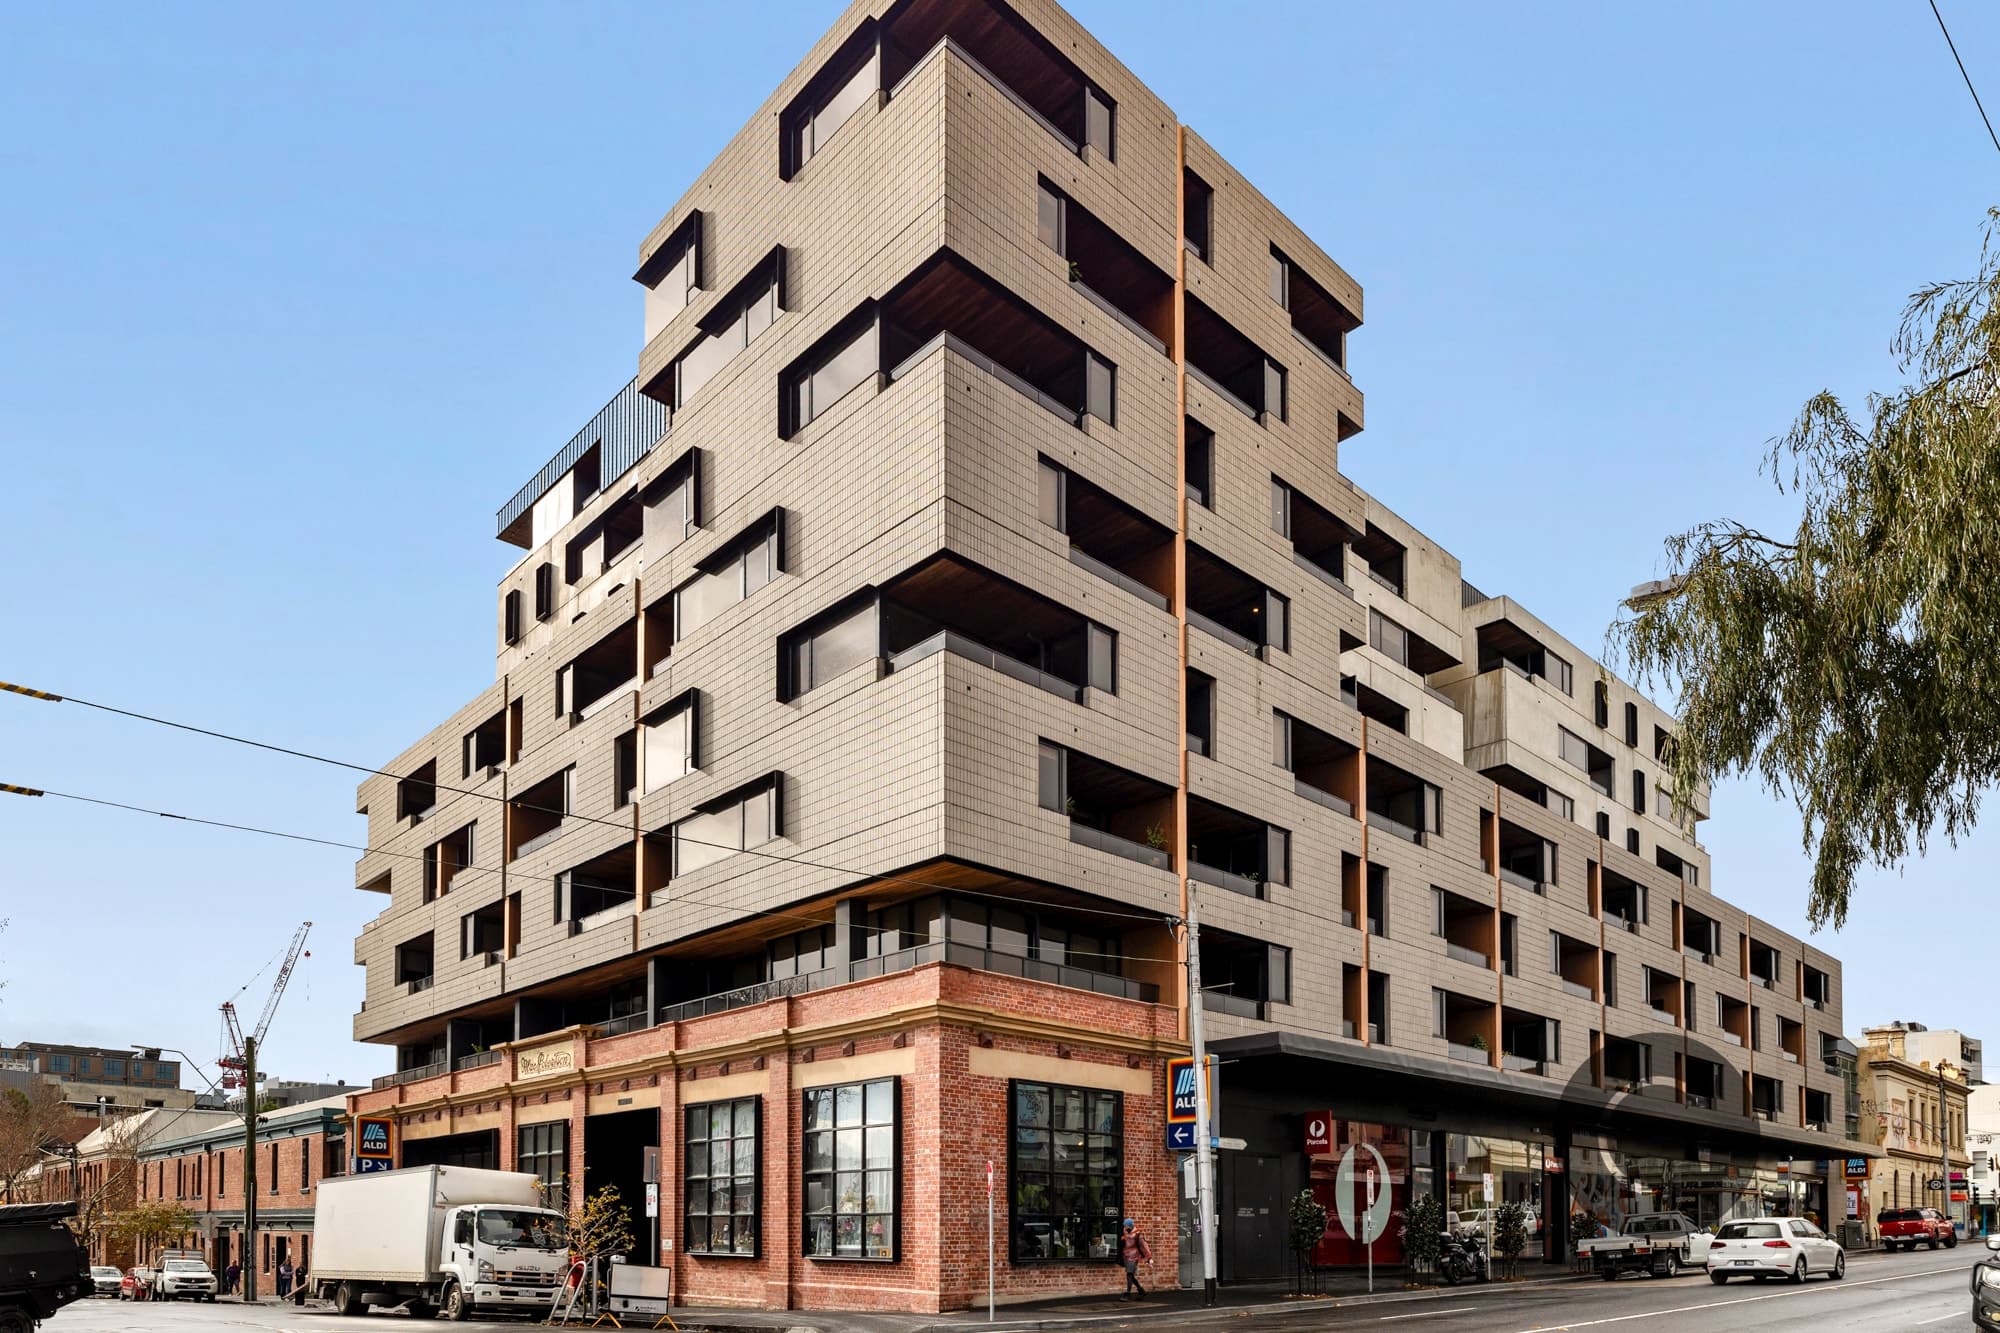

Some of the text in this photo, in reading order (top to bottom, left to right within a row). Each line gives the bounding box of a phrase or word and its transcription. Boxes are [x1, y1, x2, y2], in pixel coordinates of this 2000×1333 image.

[1175, 1096, 1197, 1109] ALD
[363, 1141, 387, 1150] ALDI
[1306, 1138, 1328, 1146] Parcels
[362, 1159, 372, 1172] P
